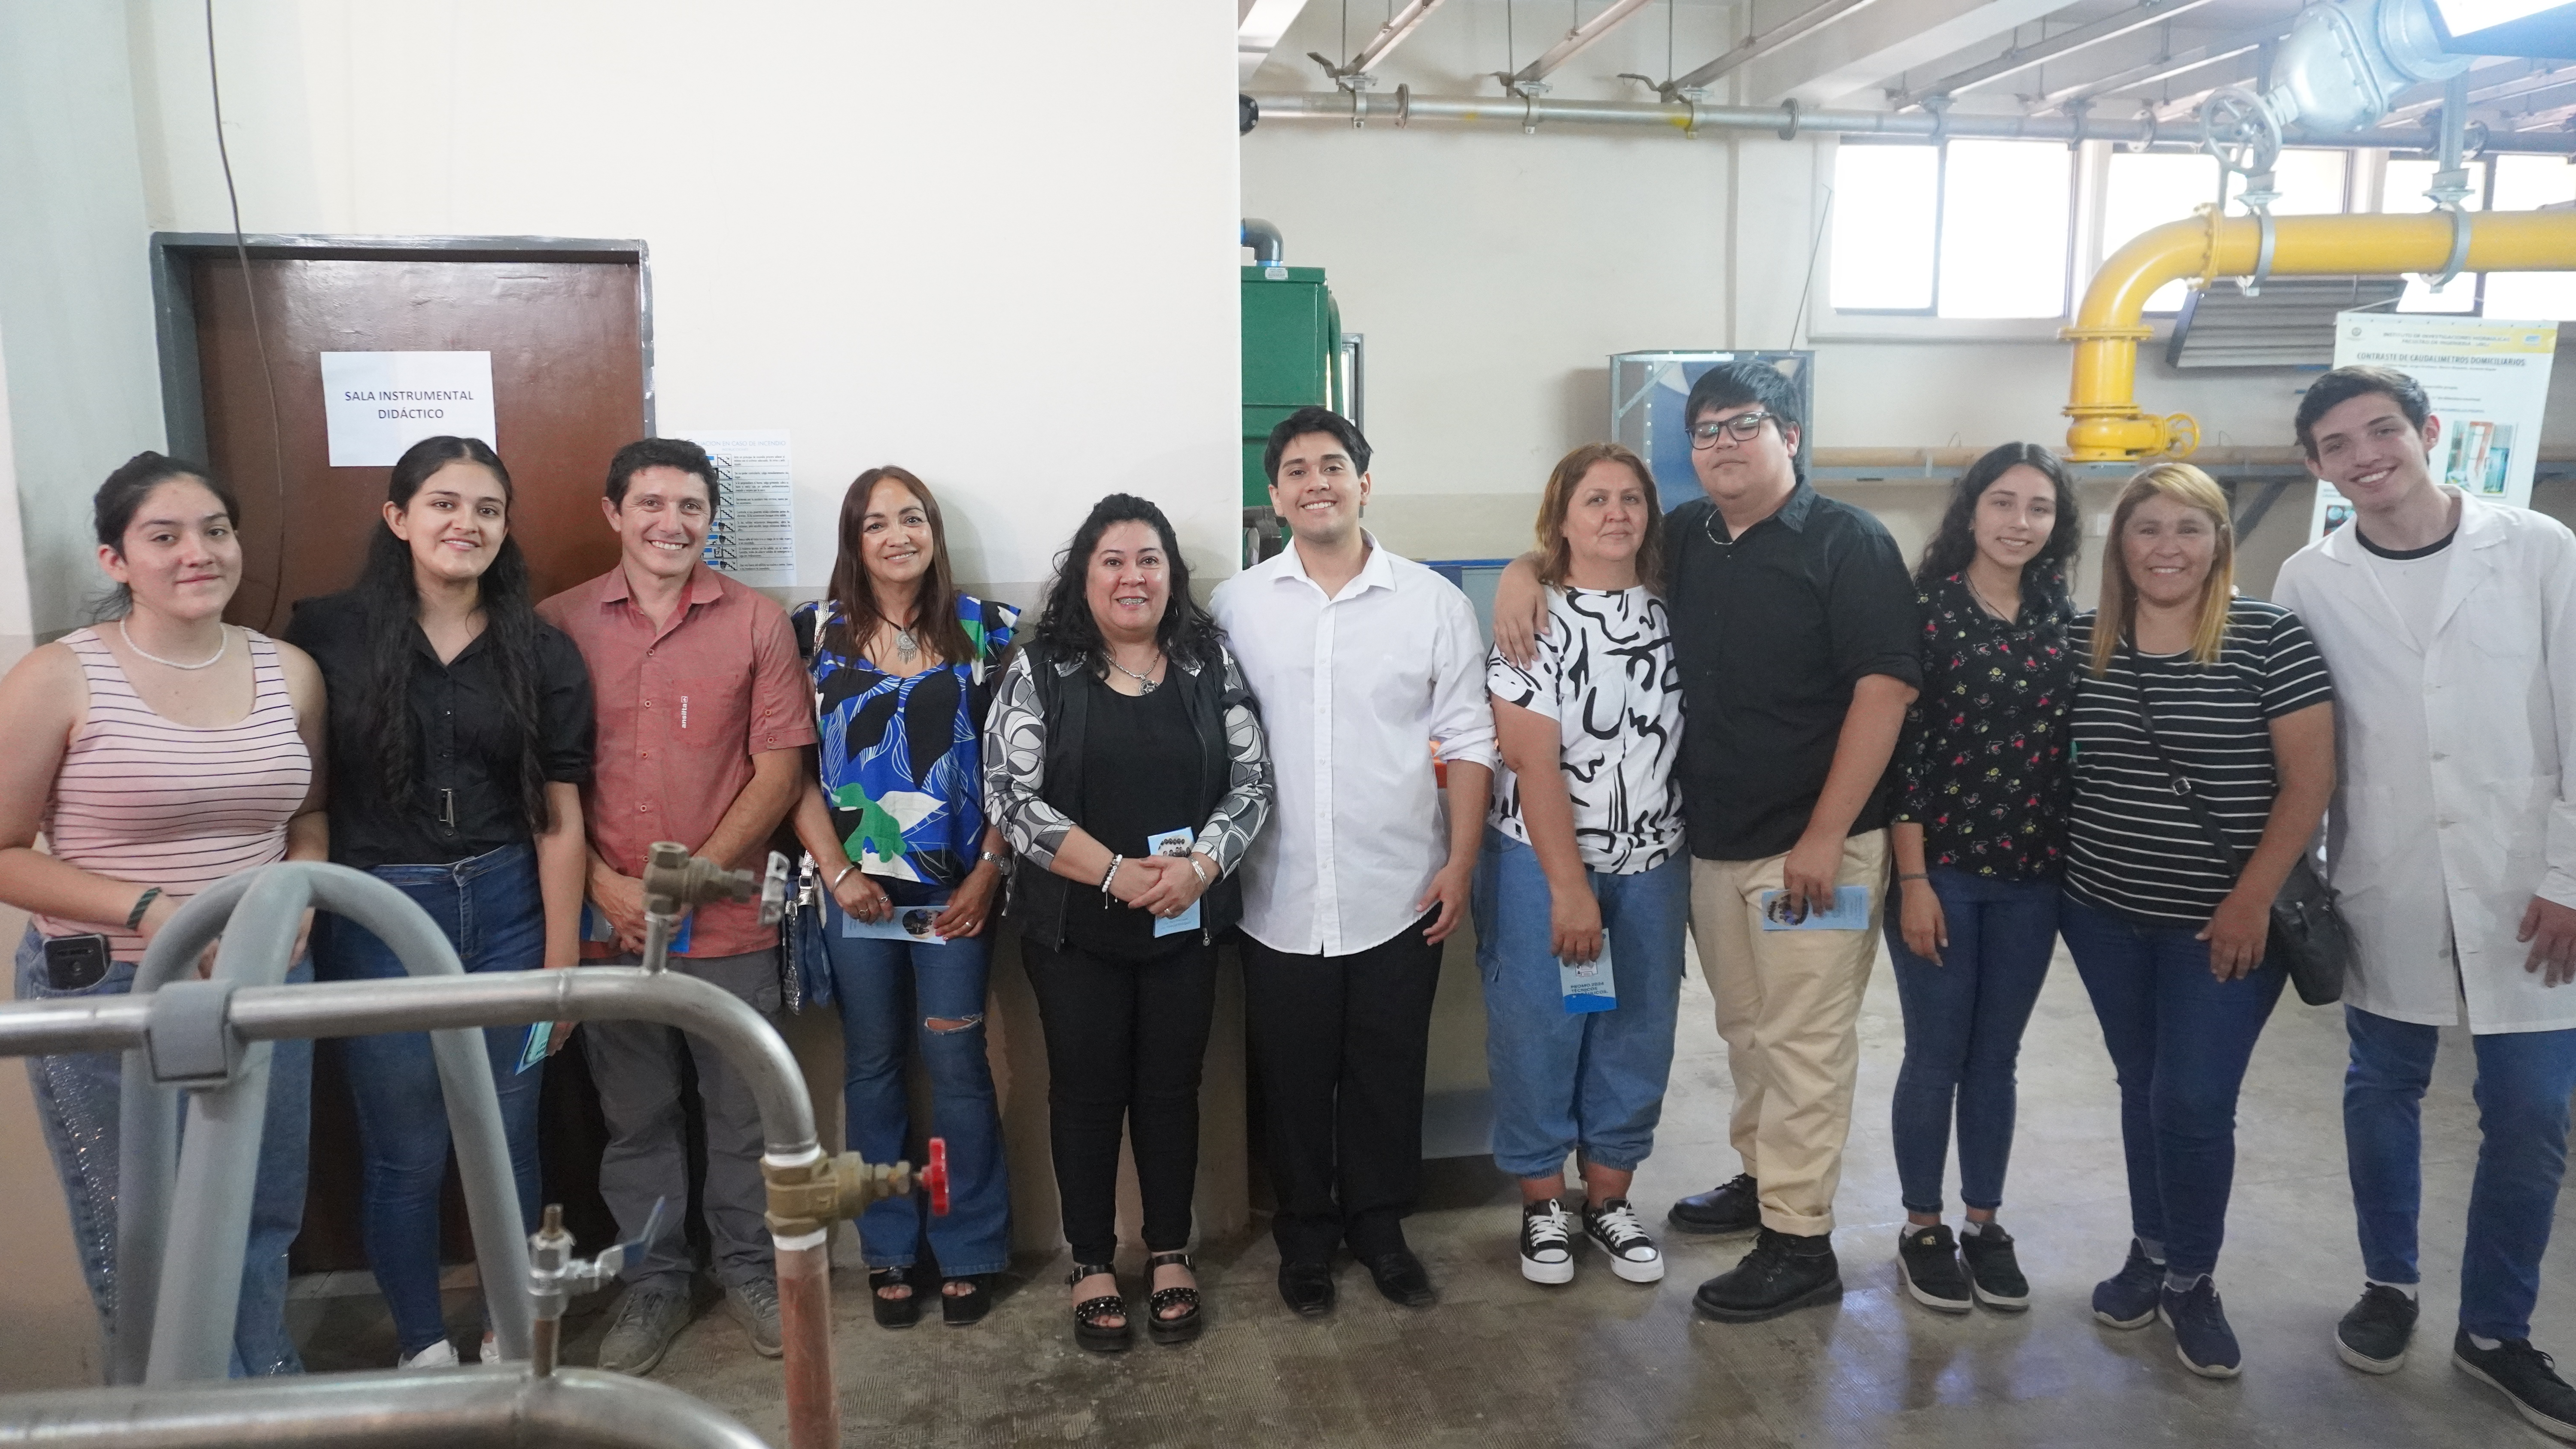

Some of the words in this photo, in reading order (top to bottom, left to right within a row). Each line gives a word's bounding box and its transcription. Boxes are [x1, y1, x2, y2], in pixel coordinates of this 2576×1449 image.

[2471, 357, 2525, 366] DOMICILIARIOS
[345, 391, 375, 401] SALA
[379, 391, 474, 400] INSTRUMENTAL
[378, 407, 444, 418] DIDÁCTICO
